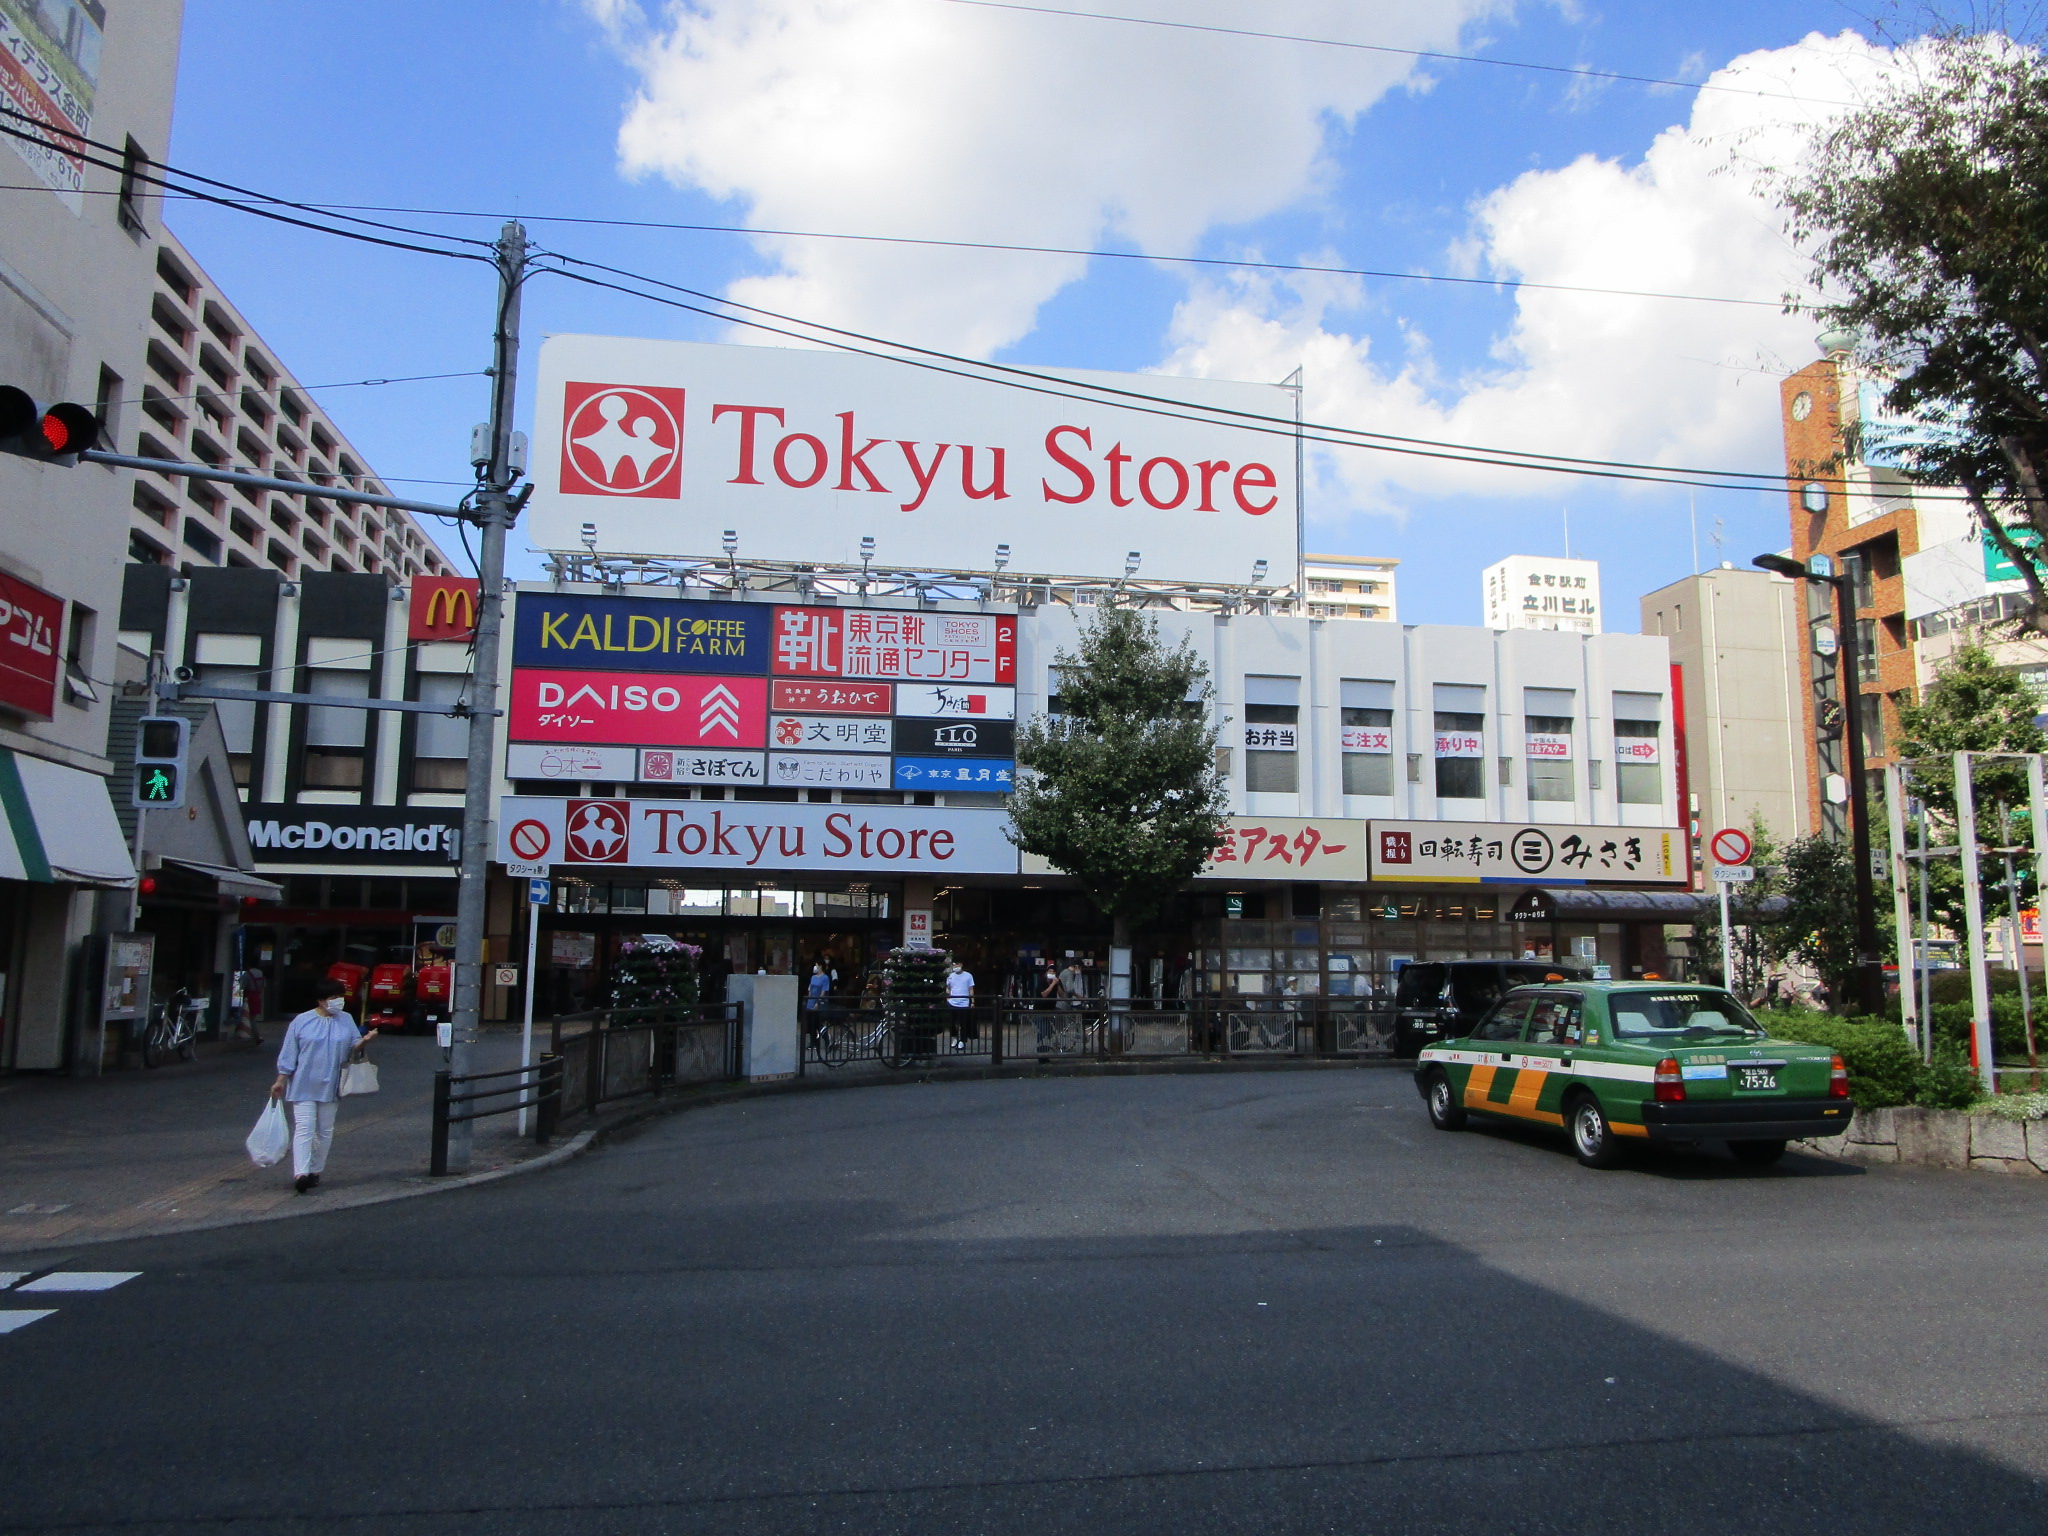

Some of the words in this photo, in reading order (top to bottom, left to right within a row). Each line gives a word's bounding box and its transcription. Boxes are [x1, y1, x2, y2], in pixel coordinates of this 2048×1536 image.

[712, 403, 1010, 512] Tokyu
[1042, 425, 1279, 516] Store
[1528, 573, 1587, 589] 金町駅前
[1523, 594, 1595, 614] 立川ビル
[541, 612, 671, 653] KALDI
[676, 618, 746, 638] COFFEE
[849, 613, 926, 645] 東京靴
[676, 636, 746, 656] FARM
[778, 611, 839, 671] 靴
[847, 645, 990, 678] 流通センター
[538, 682, 681, 712] DAISO
[817, 689, 879, 704] うおひで
[538, 714, 594, 728] ダイソー
[807, 722, 887, 744] 文明堂
[934, 727, 977, 743] FLO
[1245, 729, 1294, 746] お弁当
[1341, 732, 1388, 748] ご注文
[1435, 737, 1478, 752] 承り中
[692, 759, 759, 777] さぼてん
[804, 768, 882, 783] こだわりや
[644, 808, 806, 866] Tokyu
[822, 813, 956, 860] Store
[1386, 836, 1408, 847] 職人
[1419, 834, 1503, 866] 回転寿司
[1560, 834, 1642, 870] みさき
[1745, 1075, 1776, 1088] 75-26
